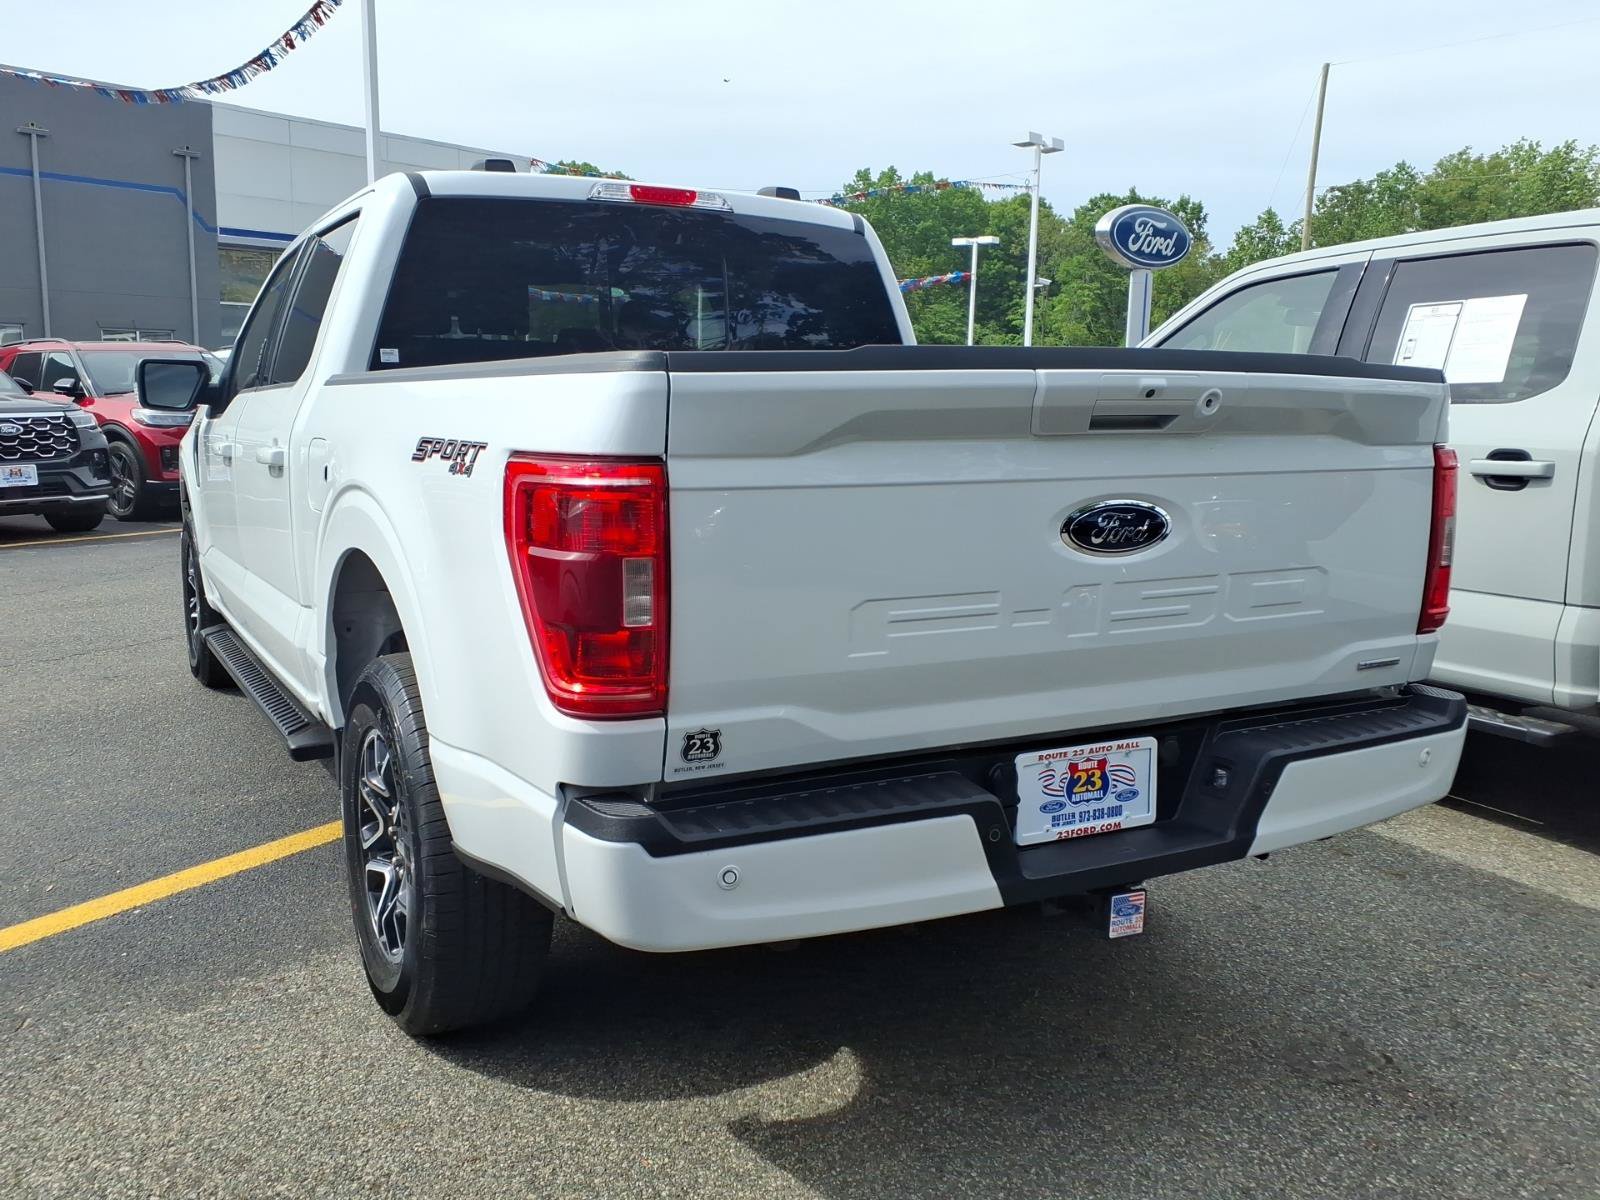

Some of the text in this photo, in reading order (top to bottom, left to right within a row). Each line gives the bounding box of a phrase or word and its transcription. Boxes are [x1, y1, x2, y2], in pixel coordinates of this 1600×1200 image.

[1128, 217, 1177, 256] Ford
[411, 436, 488, 464] SPORT
[1090, 511, 1150, 544] Ford
[848, 565, 1328, 658] F-150
[688, 738, 715, 754] 23
[1038, 751, 1069, 762] ROUTE
[1088, 745, 1113, 754] AUTO
[1116, 741, 1140, 751] MALL
[1078, 761, 1098, 770] ROUTE
[1073, 769, 1102, 793] 23
[1071, 790, 1104, 802] AUTOMALL
[1051, 812, 1076, 822] BUTLER
[1056, 821, 1122, 839] 23FORD.COM
